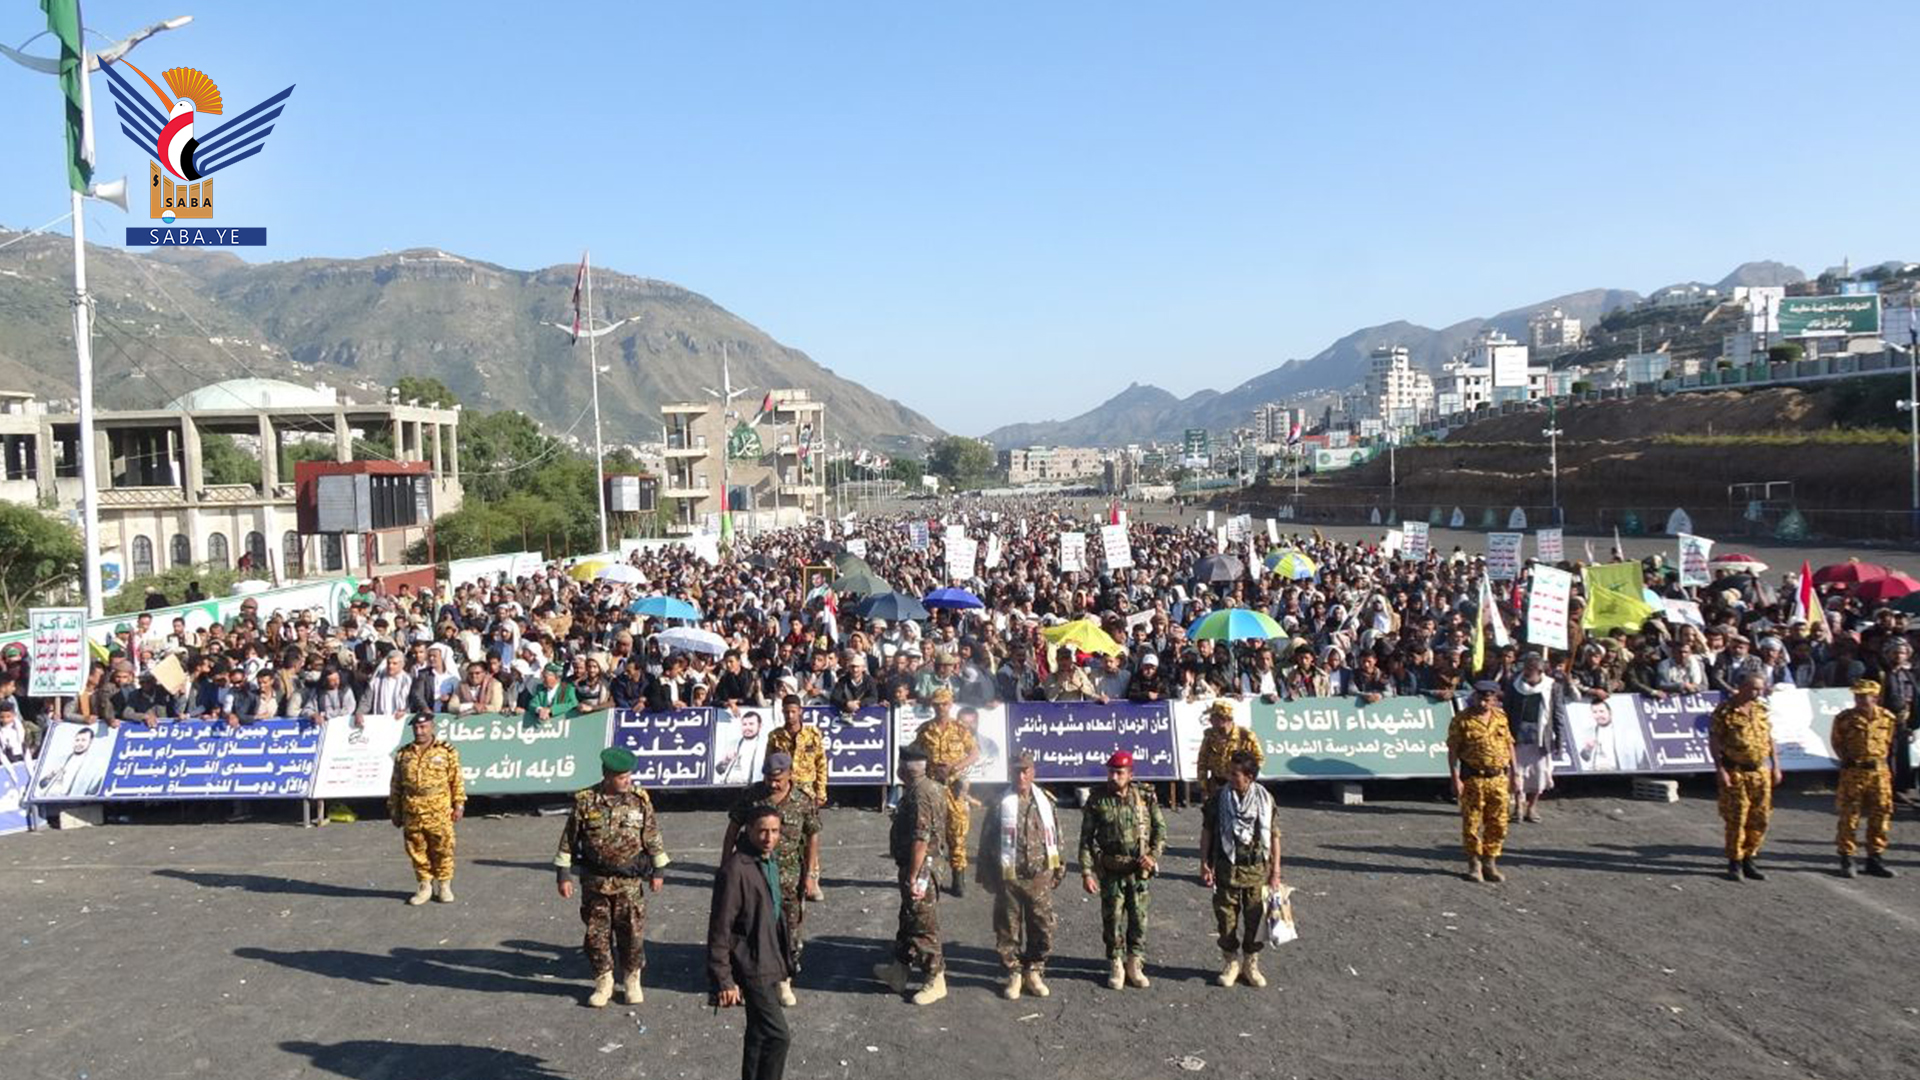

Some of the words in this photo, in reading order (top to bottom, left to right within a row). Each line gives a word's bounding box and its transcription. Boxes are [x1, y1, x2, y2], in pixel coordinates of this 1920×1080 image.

[620, 711, 649, 733] بنا
[654, 709, 710, 732] اضرب
[802, 709, 882, 733] جودك
[1014, 714, 1048, 742] وثائقي
[1049, 713, 1084, 737] مشهد
[1085, 712, 1117, 731] أعطاه
[1118, 717, 1148, 735] الزمان
[1150, 712, 1169, 734] كأن
[1275, 707, 1340, 731] القادة
[1346, 707, 1435, 735] الشهداء
[171, 724, 192, 740] درة
[235, 726, 268, 740] جبين
[272, 722, 300, 742] في
[490, 719, 571, 744] الشهادة
[155, 742, 216, 760] الكرام
[821, 731, 885, 757] سيوف
[1132, 745, 1149, 761] الله
[1266, 739, 1323, 757] الشهادة
[1325, 738, 1380, 756] لمدرسة
[1382, 739, 1426, 759] نماذج
[276, 759, 312, 775] وانشر
[485, 754, 522, 780] الله
[827, 757, 886, 777] عصا
[1043, 748, 1083, 766] وينبوعه
[133, 762, 167, 778] فينا
[168, 760, 219, 777] القرآن
[221, 761, 274, 775] هدى
[525, 755, 576, 783] قابله
[630, 760, 706, 785] الطواغي
[104, 779, 164, 797] سبيل
[166, 779, 232, 796] للنجاة
